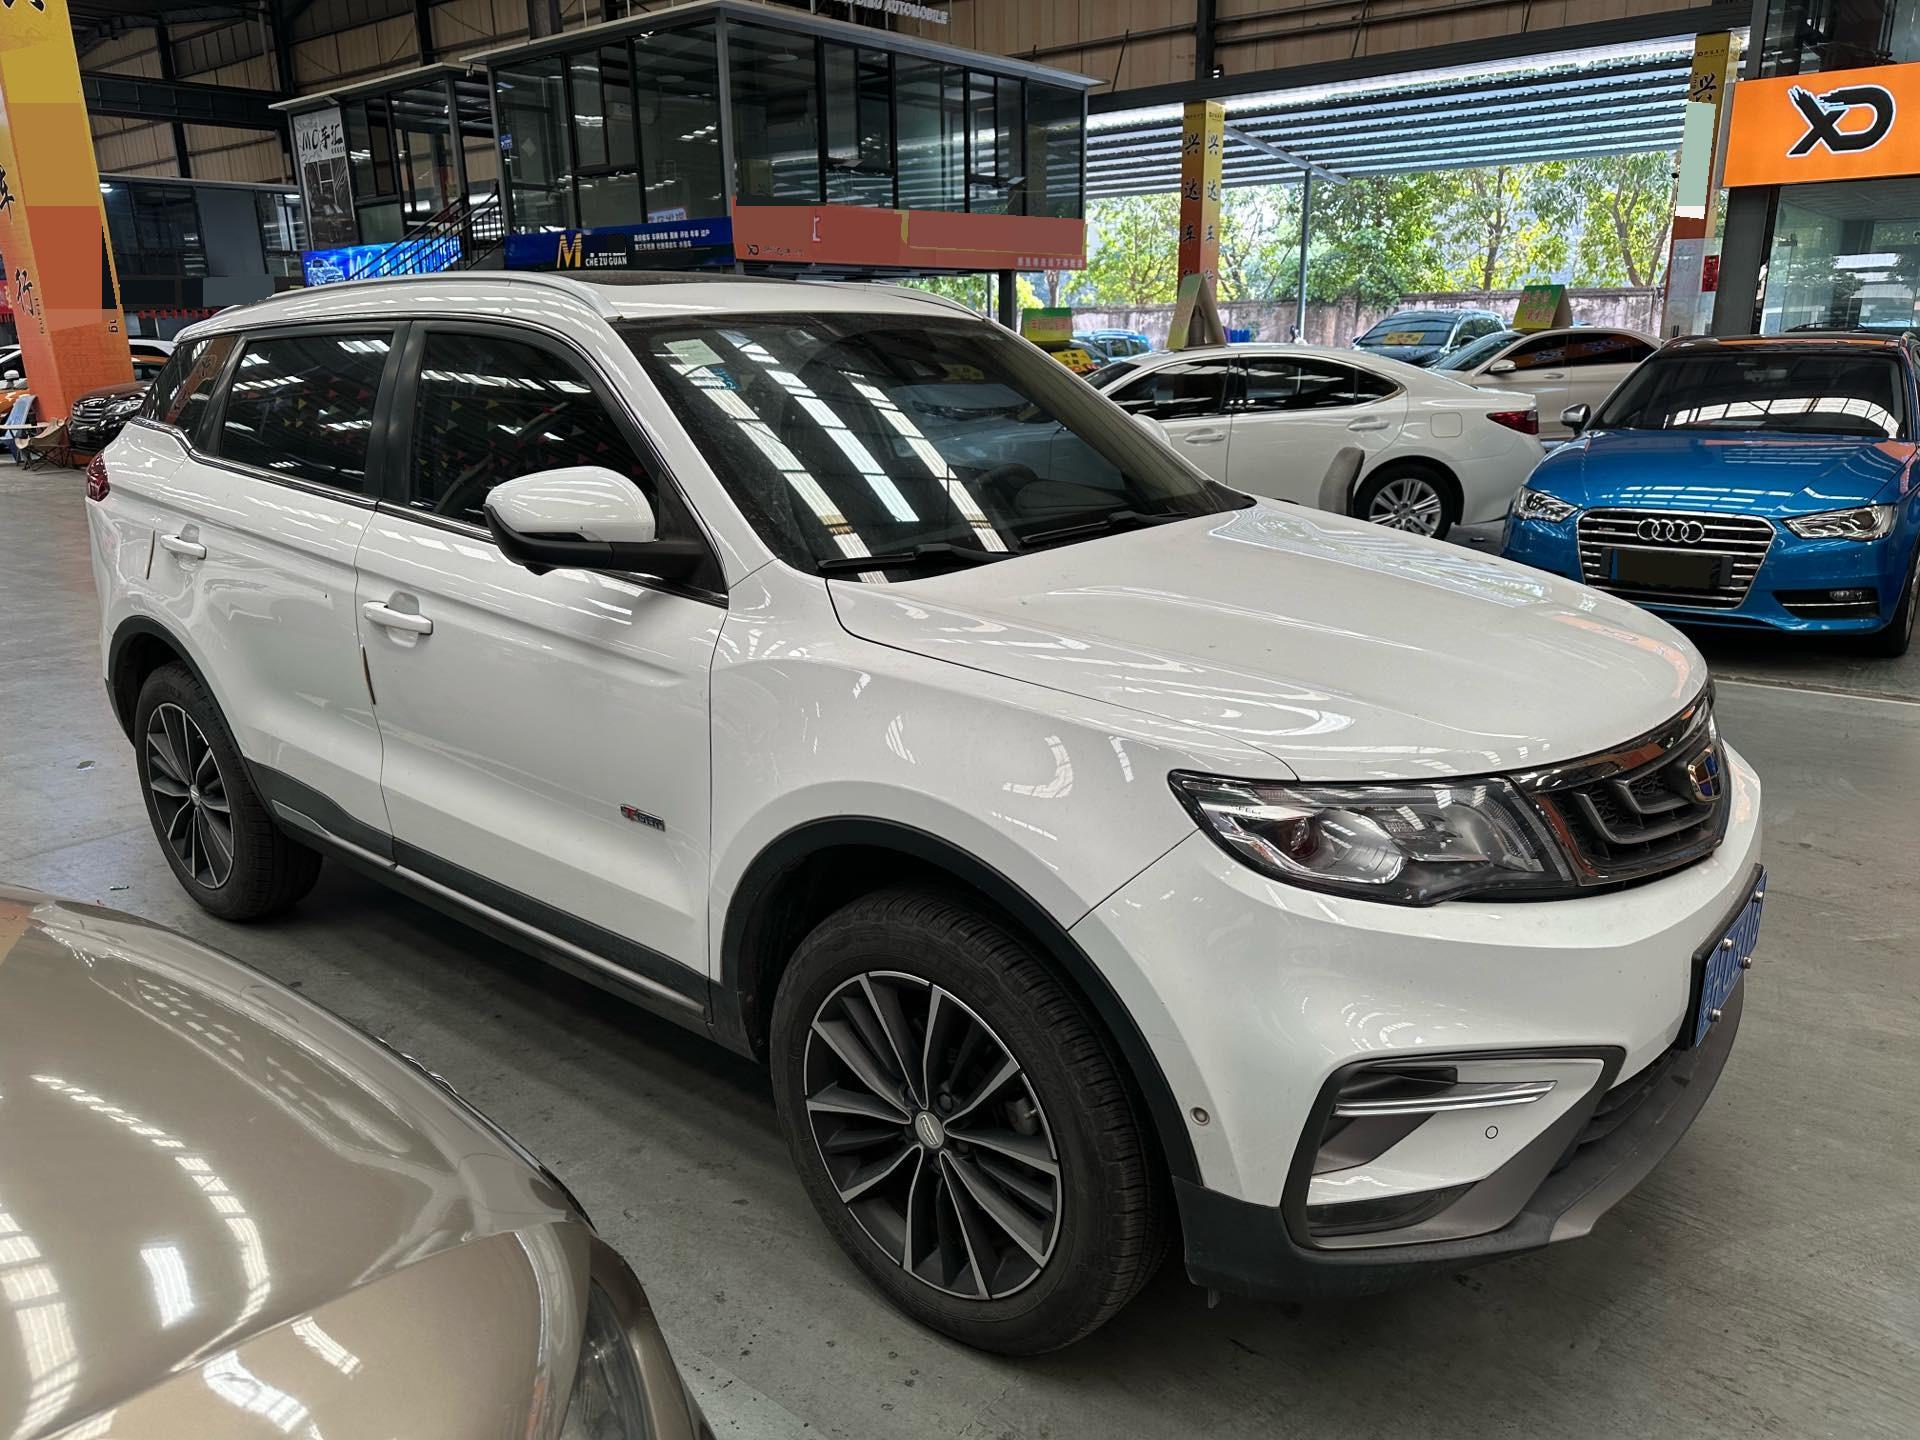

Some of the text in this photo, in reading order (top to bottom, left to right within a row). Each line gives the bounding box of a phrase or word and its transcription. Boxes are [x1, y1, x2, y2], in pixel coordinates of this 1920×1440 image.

[884, 1, 949, 24] AUTOMOBILE
[1786, 84, 1896, 158] XD
[585, 257, 599, 267] CHE
[608, 256, 628, 266] GUAN
